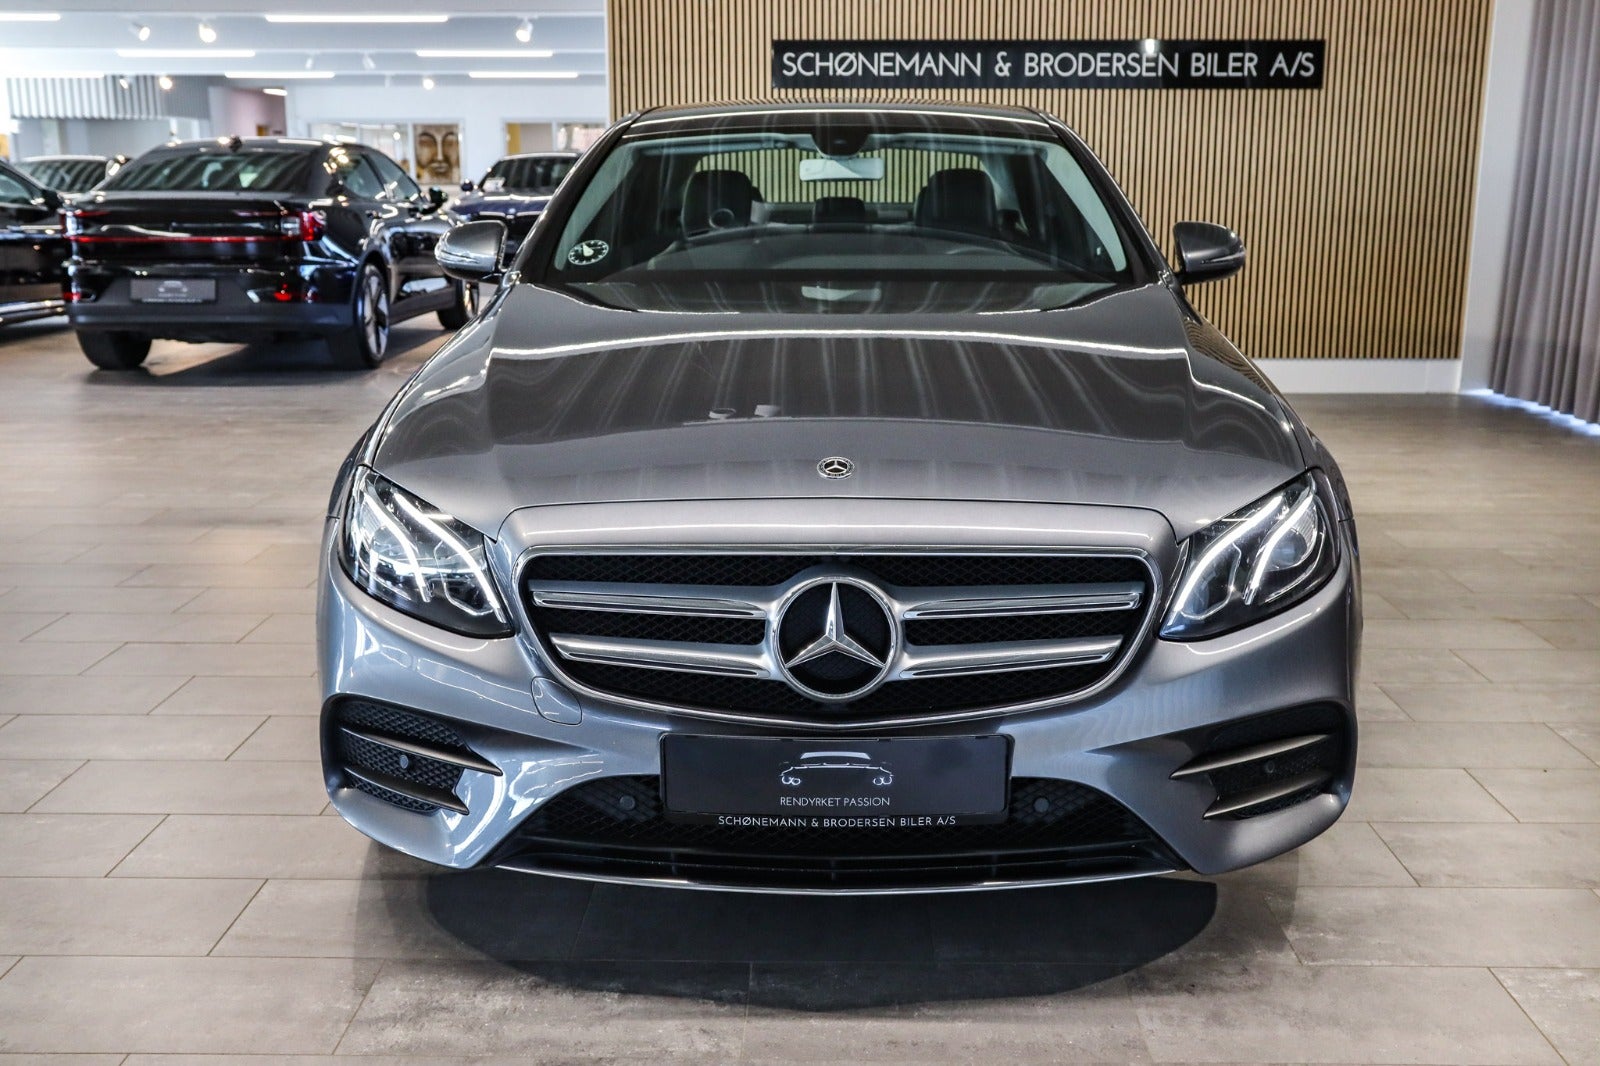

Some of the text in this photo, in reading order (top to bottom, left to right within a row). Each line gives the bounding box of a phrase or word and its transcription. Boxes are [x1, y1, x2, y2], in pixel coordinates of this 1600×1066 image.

[782, 51, 1315, 78] SCHØNEMANN & BRODERSEN BILER A/S
[780, 796, 891, 807] RENDYRKET PASSION
[718, 815, 956, 828] SCHØNEMANN & BRODERSEN BILER A/S
